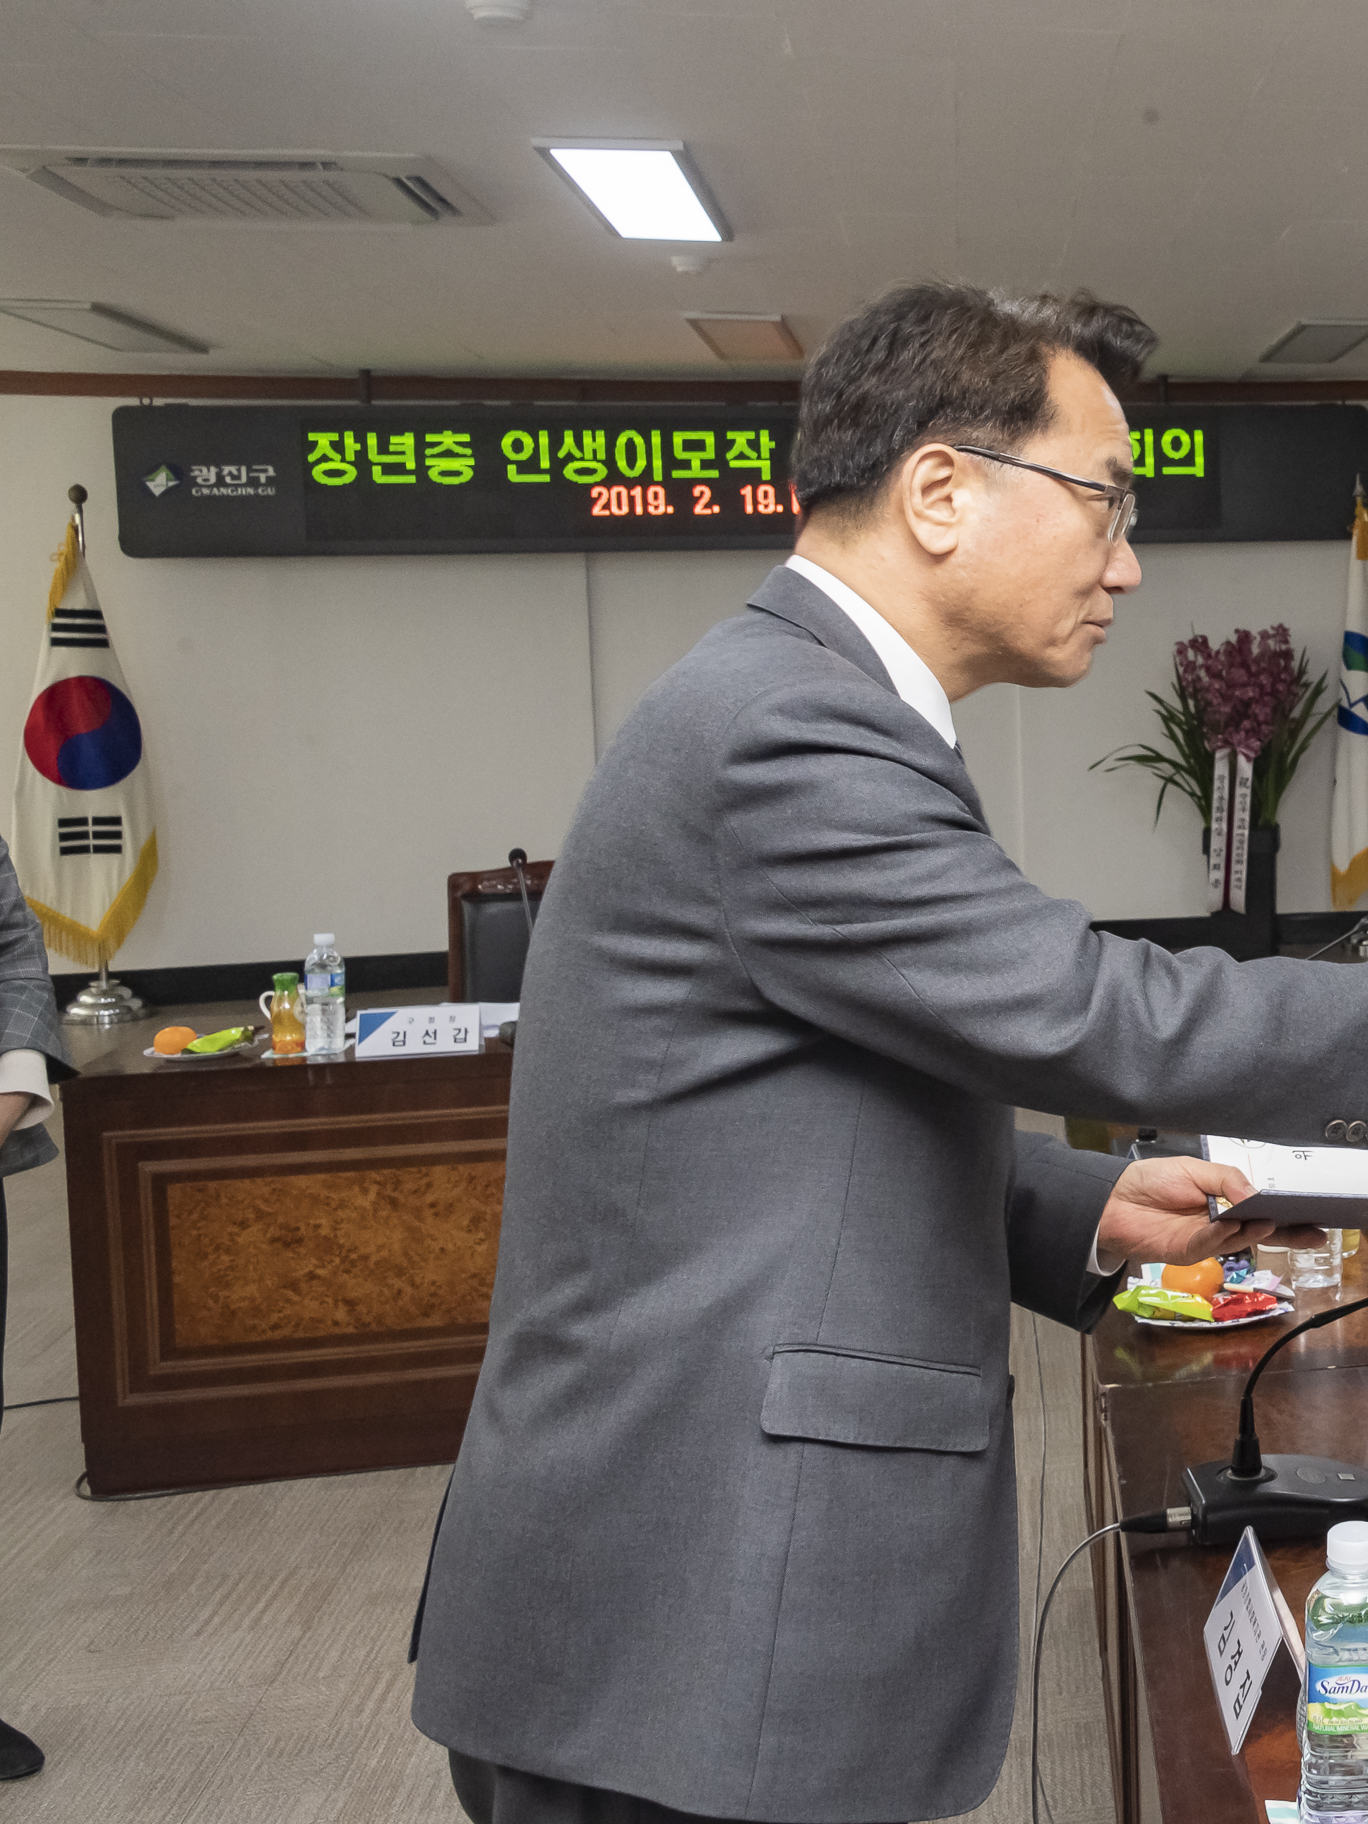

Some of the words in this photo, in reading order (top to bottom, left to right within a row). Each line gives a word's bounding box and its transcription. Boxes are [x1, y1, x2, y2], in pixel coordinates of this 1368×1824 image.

[307, 429, 476, 486] 장년층
[500, 429, 775, 485] 인생이모작
[189, 464, 277, 486] 광진구
[590, 484, 675, 516] 2019.
[691, 484, 721, 515] 2.
[390, 1027, 470, 1048] 김선갑
[1217, 1609, 1253, 1721] 김경집
[1312, 1723, 1336, 1732] NATURAL
[1336, 1723, 1360, 1732] MINERAL
